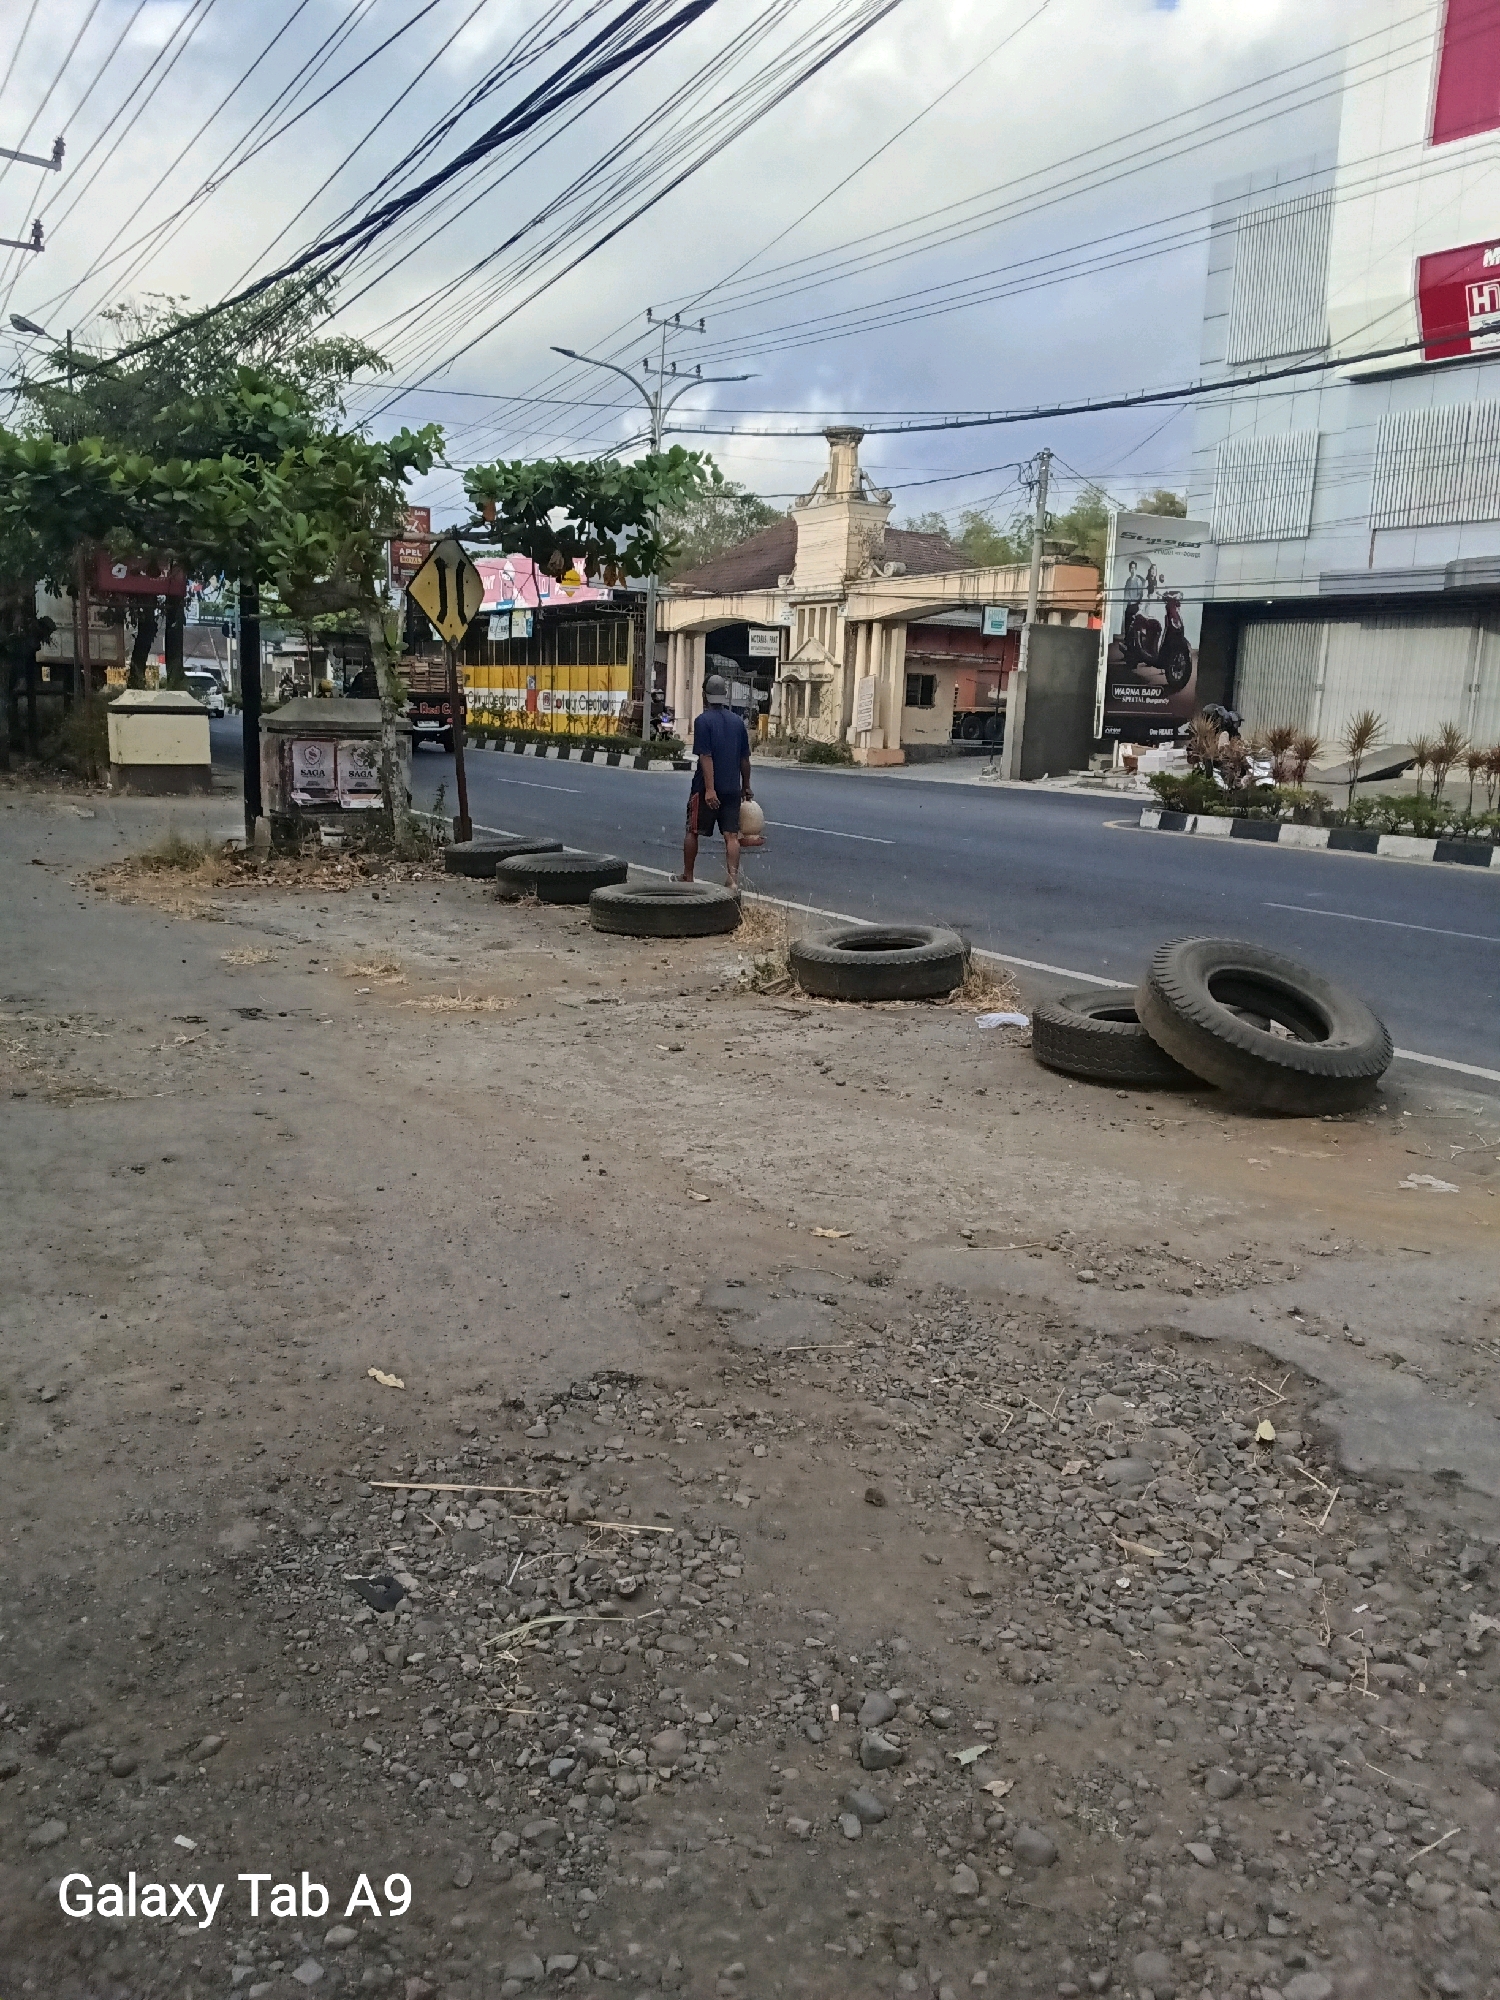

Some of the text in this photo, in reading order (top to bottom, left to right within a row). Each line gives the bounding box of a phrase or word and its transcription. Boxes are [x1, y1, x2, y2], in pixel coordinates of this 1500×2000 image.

[399, 547, 422, 557] APEL
[401, 556, 421, 564] ROYAL
[1114, 688, 1161, 697] WARNA BARU
[300, 769, 326, 777] SAGA
[348, 770, 374, 778] SAGA
